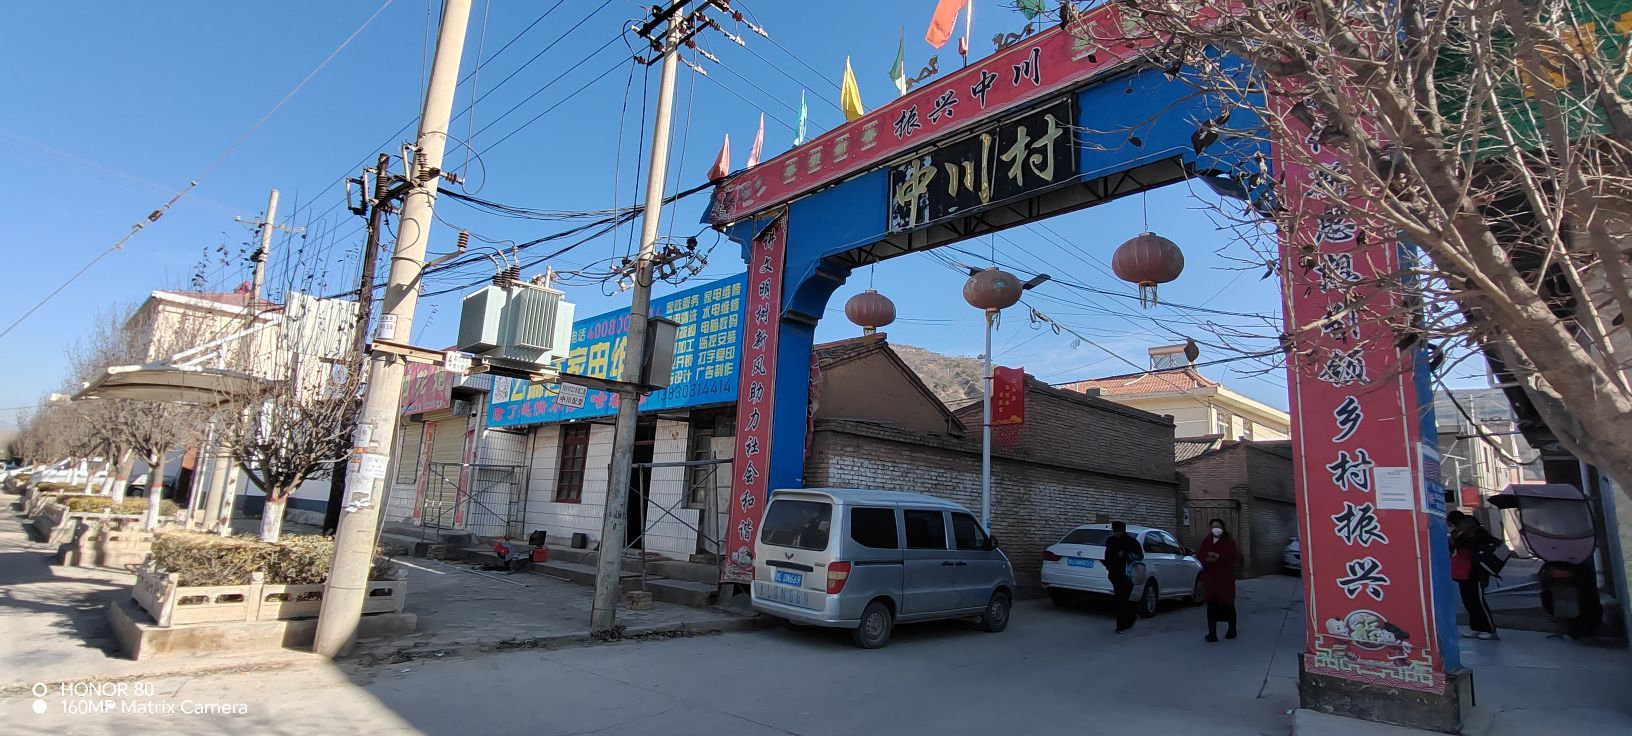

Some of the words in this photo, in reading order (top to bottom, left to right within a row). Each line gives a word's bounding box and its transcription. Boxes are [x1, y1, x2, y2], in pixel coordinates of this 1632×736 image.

[893, 47, 1041, 140] 振兴中川
[896, 114, 1064, 227] 中川村
[703, 282, 741, 304] 家电维修
[702, 298, 739, 319] 水电维修
[698, 346, 735, 365] 打字复印
[696, 362, 733, 380] 广告制作
[738, 228, 777, 542] 讲文明树新风助力社会和谐
